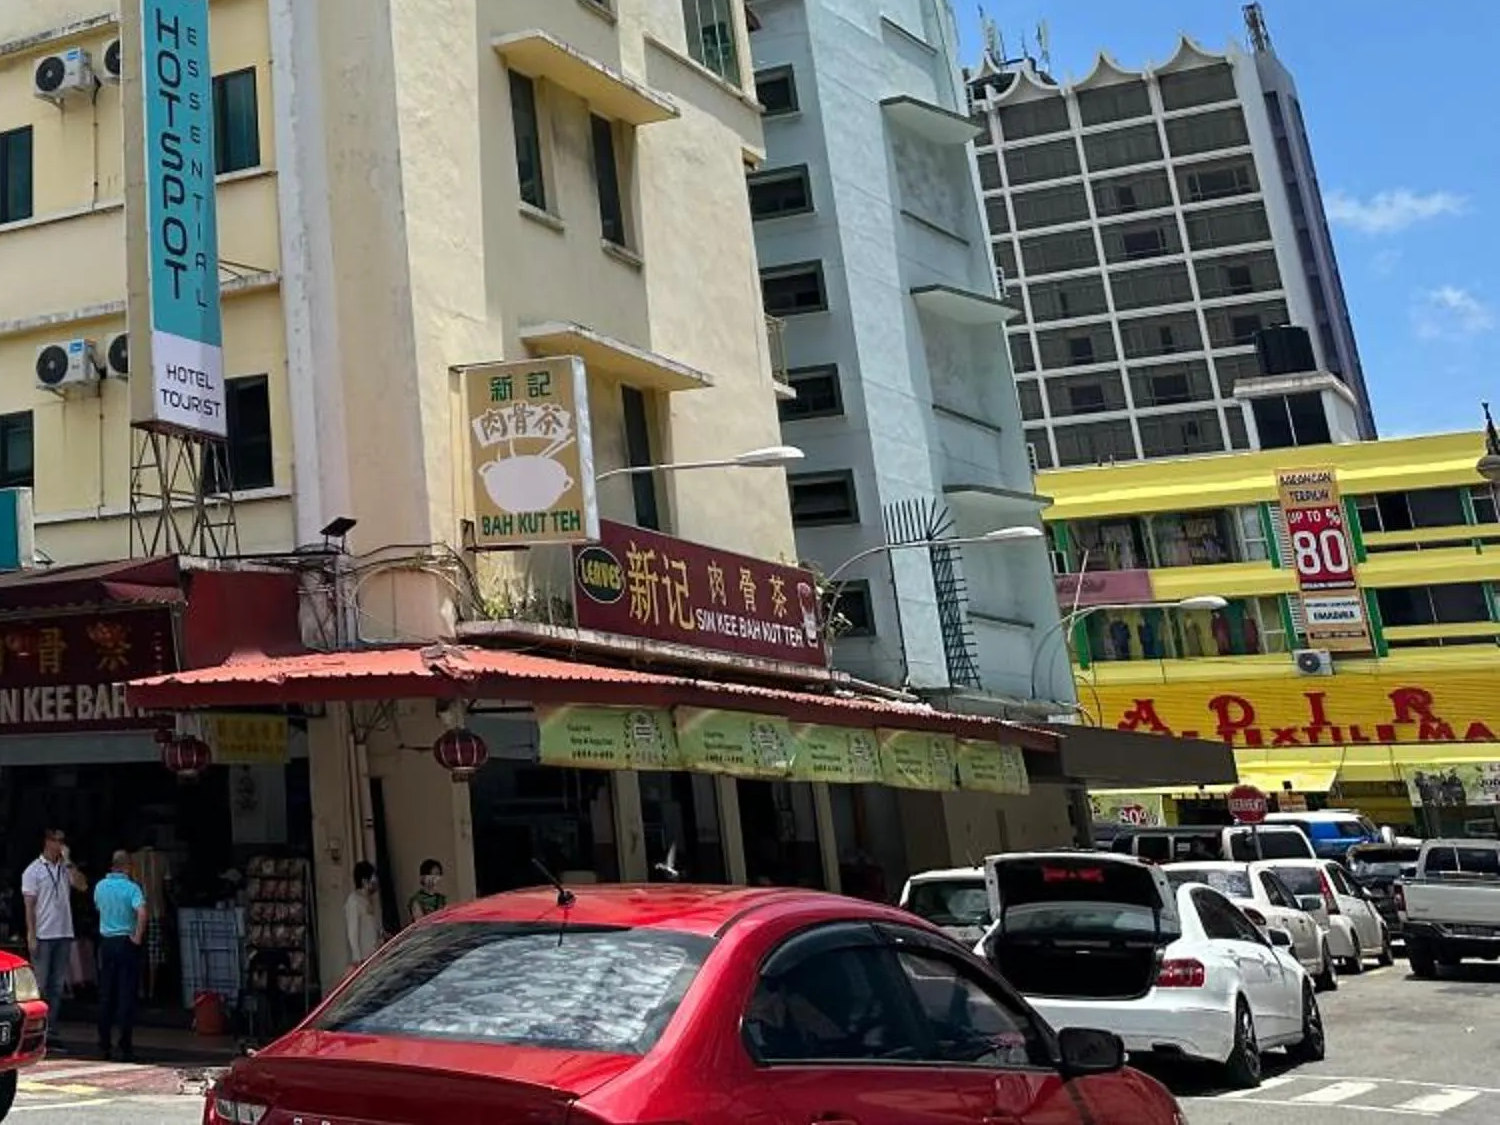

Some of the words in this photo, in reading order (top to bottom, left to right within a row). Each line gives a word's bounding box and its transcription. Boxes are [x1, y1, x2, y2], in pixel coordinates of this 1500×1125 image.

[156, 7, 188, 299] HOTSPOT
[187, 26, 208, 311] ESSENTIAL
[166, 363, 214, 390] HOTEL
[490, 371, 552, 402] 新記
[160, 388, 222, 418] TOURIST
[480, 402, 564, 441] 肉骨茶
[482, 515, 513, 536] BAH
[516, 512, 547, 535] KUT
[549, 509, 581, 532] TEH
[1288, 511, 1303, 524] UP
[1306, 510, 1321, 523] TO
[1293, 528, 1350, 575] 80
[707, 560, 787, 618] 肉骨茶
[696, 608, 716, 633] SIN
[717, 612, 738, 636] KEE
[739, 616, 761, 640] BAH
[762, 620, 783, 644] KUT
[782, 625, 804, 648] TEH
[22, 684, 75, 723] KEE
